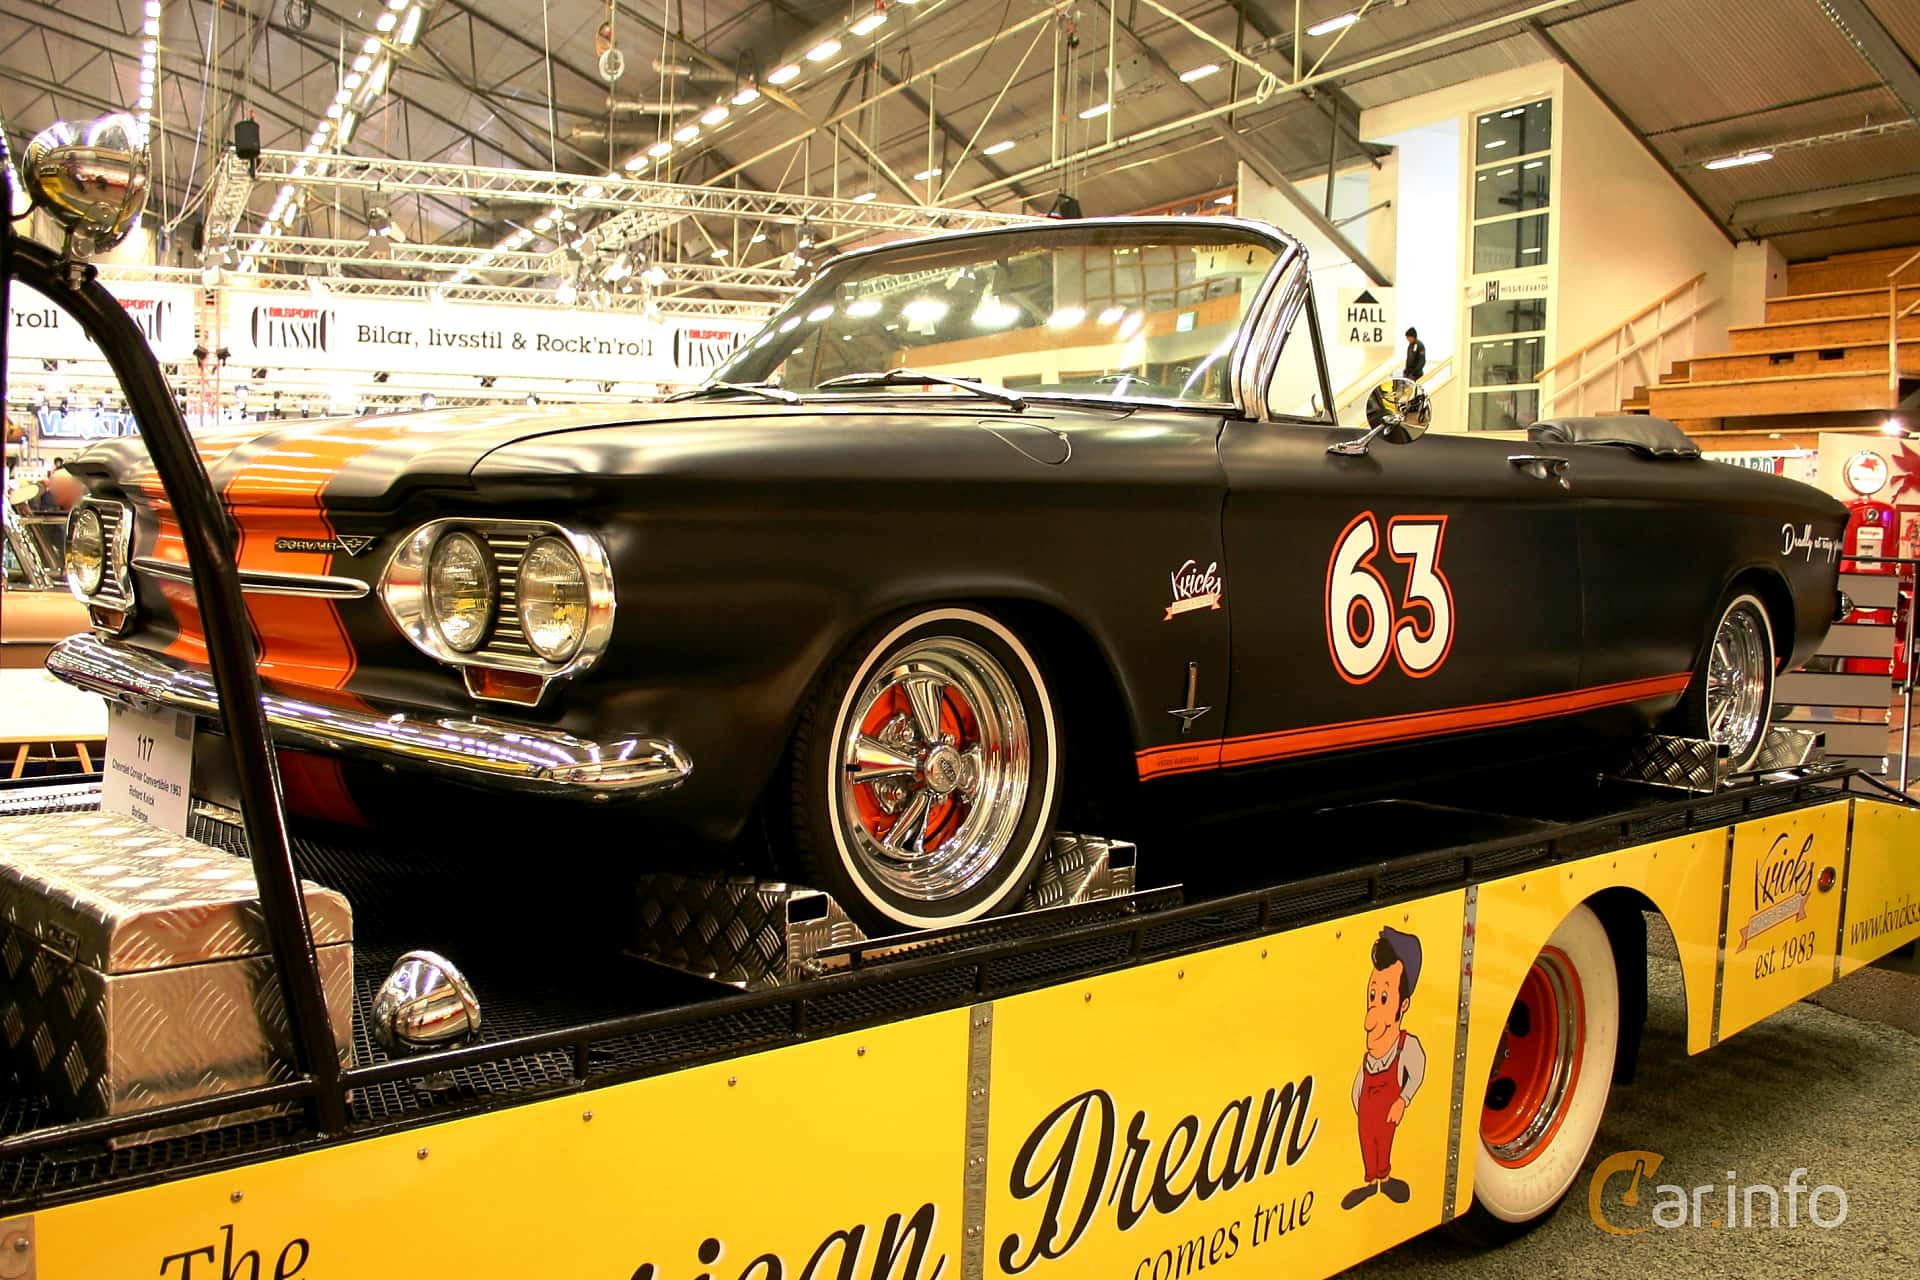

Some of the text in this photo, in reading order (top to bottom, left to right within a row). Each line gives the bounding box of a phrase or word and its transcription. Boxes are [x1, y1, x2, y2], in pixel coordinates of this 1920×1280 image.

[269, 307, 319, 319] BILSPORT
[1347, 307, 1387, 323] HALL
[357, 324, 653, 357] Bilar, livsstil & Rock'n'roll
[1350, 327, 1383, 343] A & B
[1325, 510, 1455, 685] 63
[137, 734, 154, 762] 117
[1755, 930, 1816, 980] est. 1983
[999, 1074, 1318, 1275] Dream
[1133, 1190, 1314, 1280] comes true
